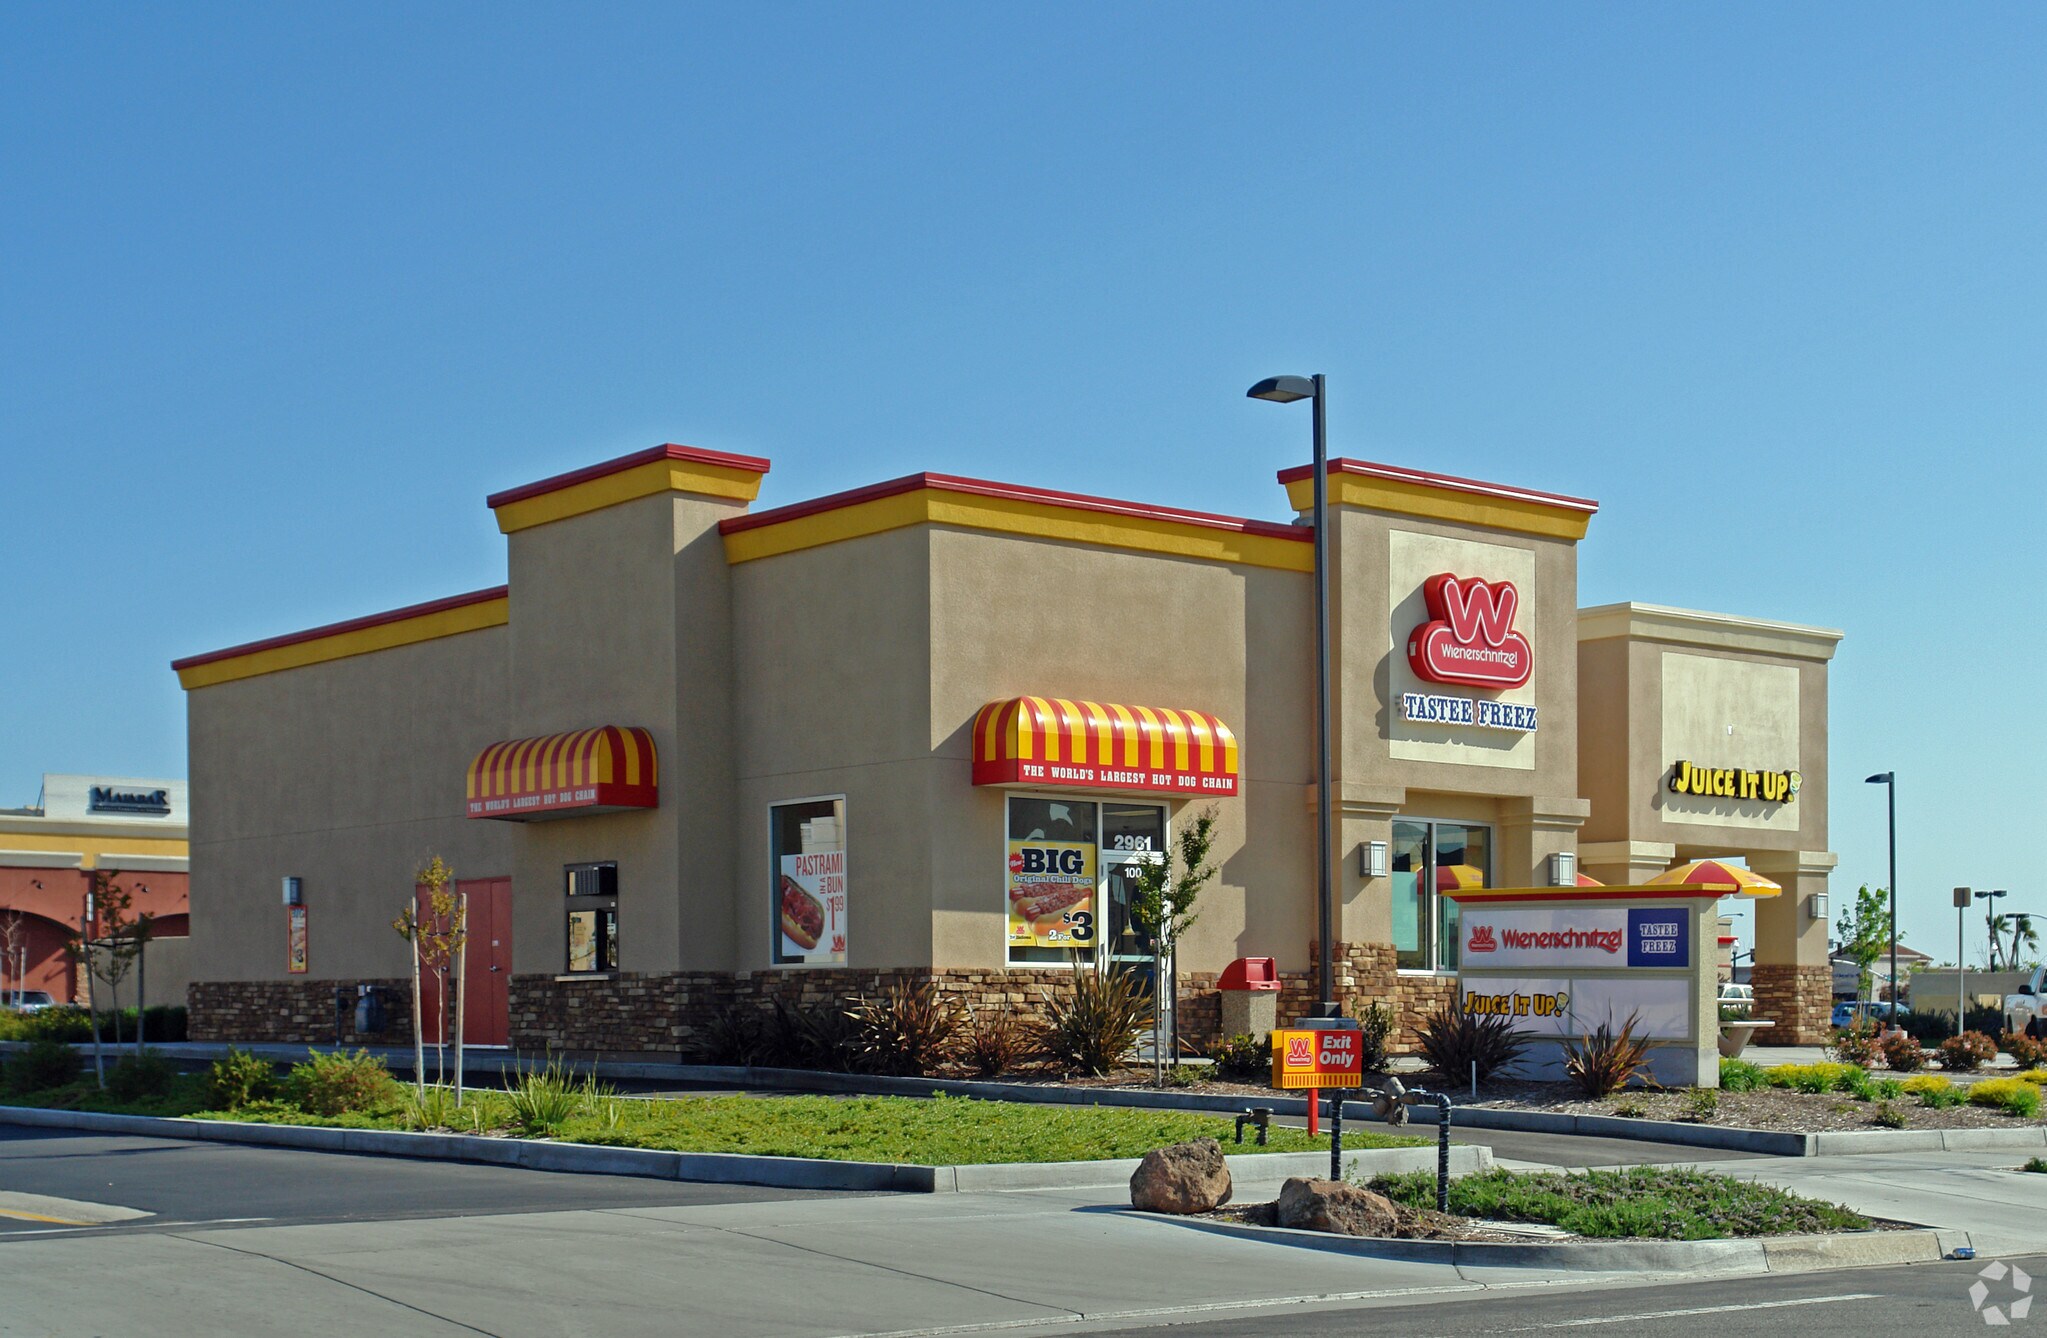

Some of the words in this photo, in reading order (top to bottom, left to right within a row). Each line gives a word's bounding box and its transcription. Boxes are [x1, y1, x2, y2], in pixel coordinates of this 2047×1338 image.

[1444, 579, 1516, 646] W
[1441, 643, 1518, 668] Wienerschnitzel
[1404, 693, 1473, 724] TASTEE
[1478, 700, 1538, 732] FREEZ
[1023, 765, 1044, 777] THE
[1051, 767, 1094, 781] WORLD'S
[1100, 770, 1146, 784] LARGEST
[1152, 774, 1172, 786] HOT
[1178, 775, 1196, 787] DOG
[1202, 777, 1233, 789] CHAIN
[1673, 760, 1736, 798] JUICE
[1737, 769, 1760, 800] IT
[470, 802, 482, 813] THE
[513, 795, 540, 809] LARGEST
[544, 793, 556, 805] HOT
[560, 791, 572, 803] DOG
[575, 788, 596, 801] CHAIN
[1114, 834, 1152, 851] 2961
[796, 853, 843, 876] PASTRAMI
[1021, 848, 1084, 875] BIG
[1013, 874, 1049, 884] Original
[1050, 875, 1071, 884] Chili
[1072, 876, 1094, 887] Dogs
[1124, 867, 1142, 879] 100
[827, 876, 843, 894] BUN
[1048, 929, 1057, 940] 2
[1058, 933, 1071, 941] For
[1501, 927, 1623, 953] Wienerschnitzel
[1640, 924, 1678, 936] TASTEE
[1641, 939, 1676, 953] FREEZ
[1463, 991, 1510, 1015] JUICE
[1514, 994, 1530, 1016] IT
[1534, 992, 1569, 1017] UP!
[1289, 1038, 1310, 1057] W
[1322, 1035, 1352, 1049] Exit
[1320, 1051, 1355, 1068] Only
